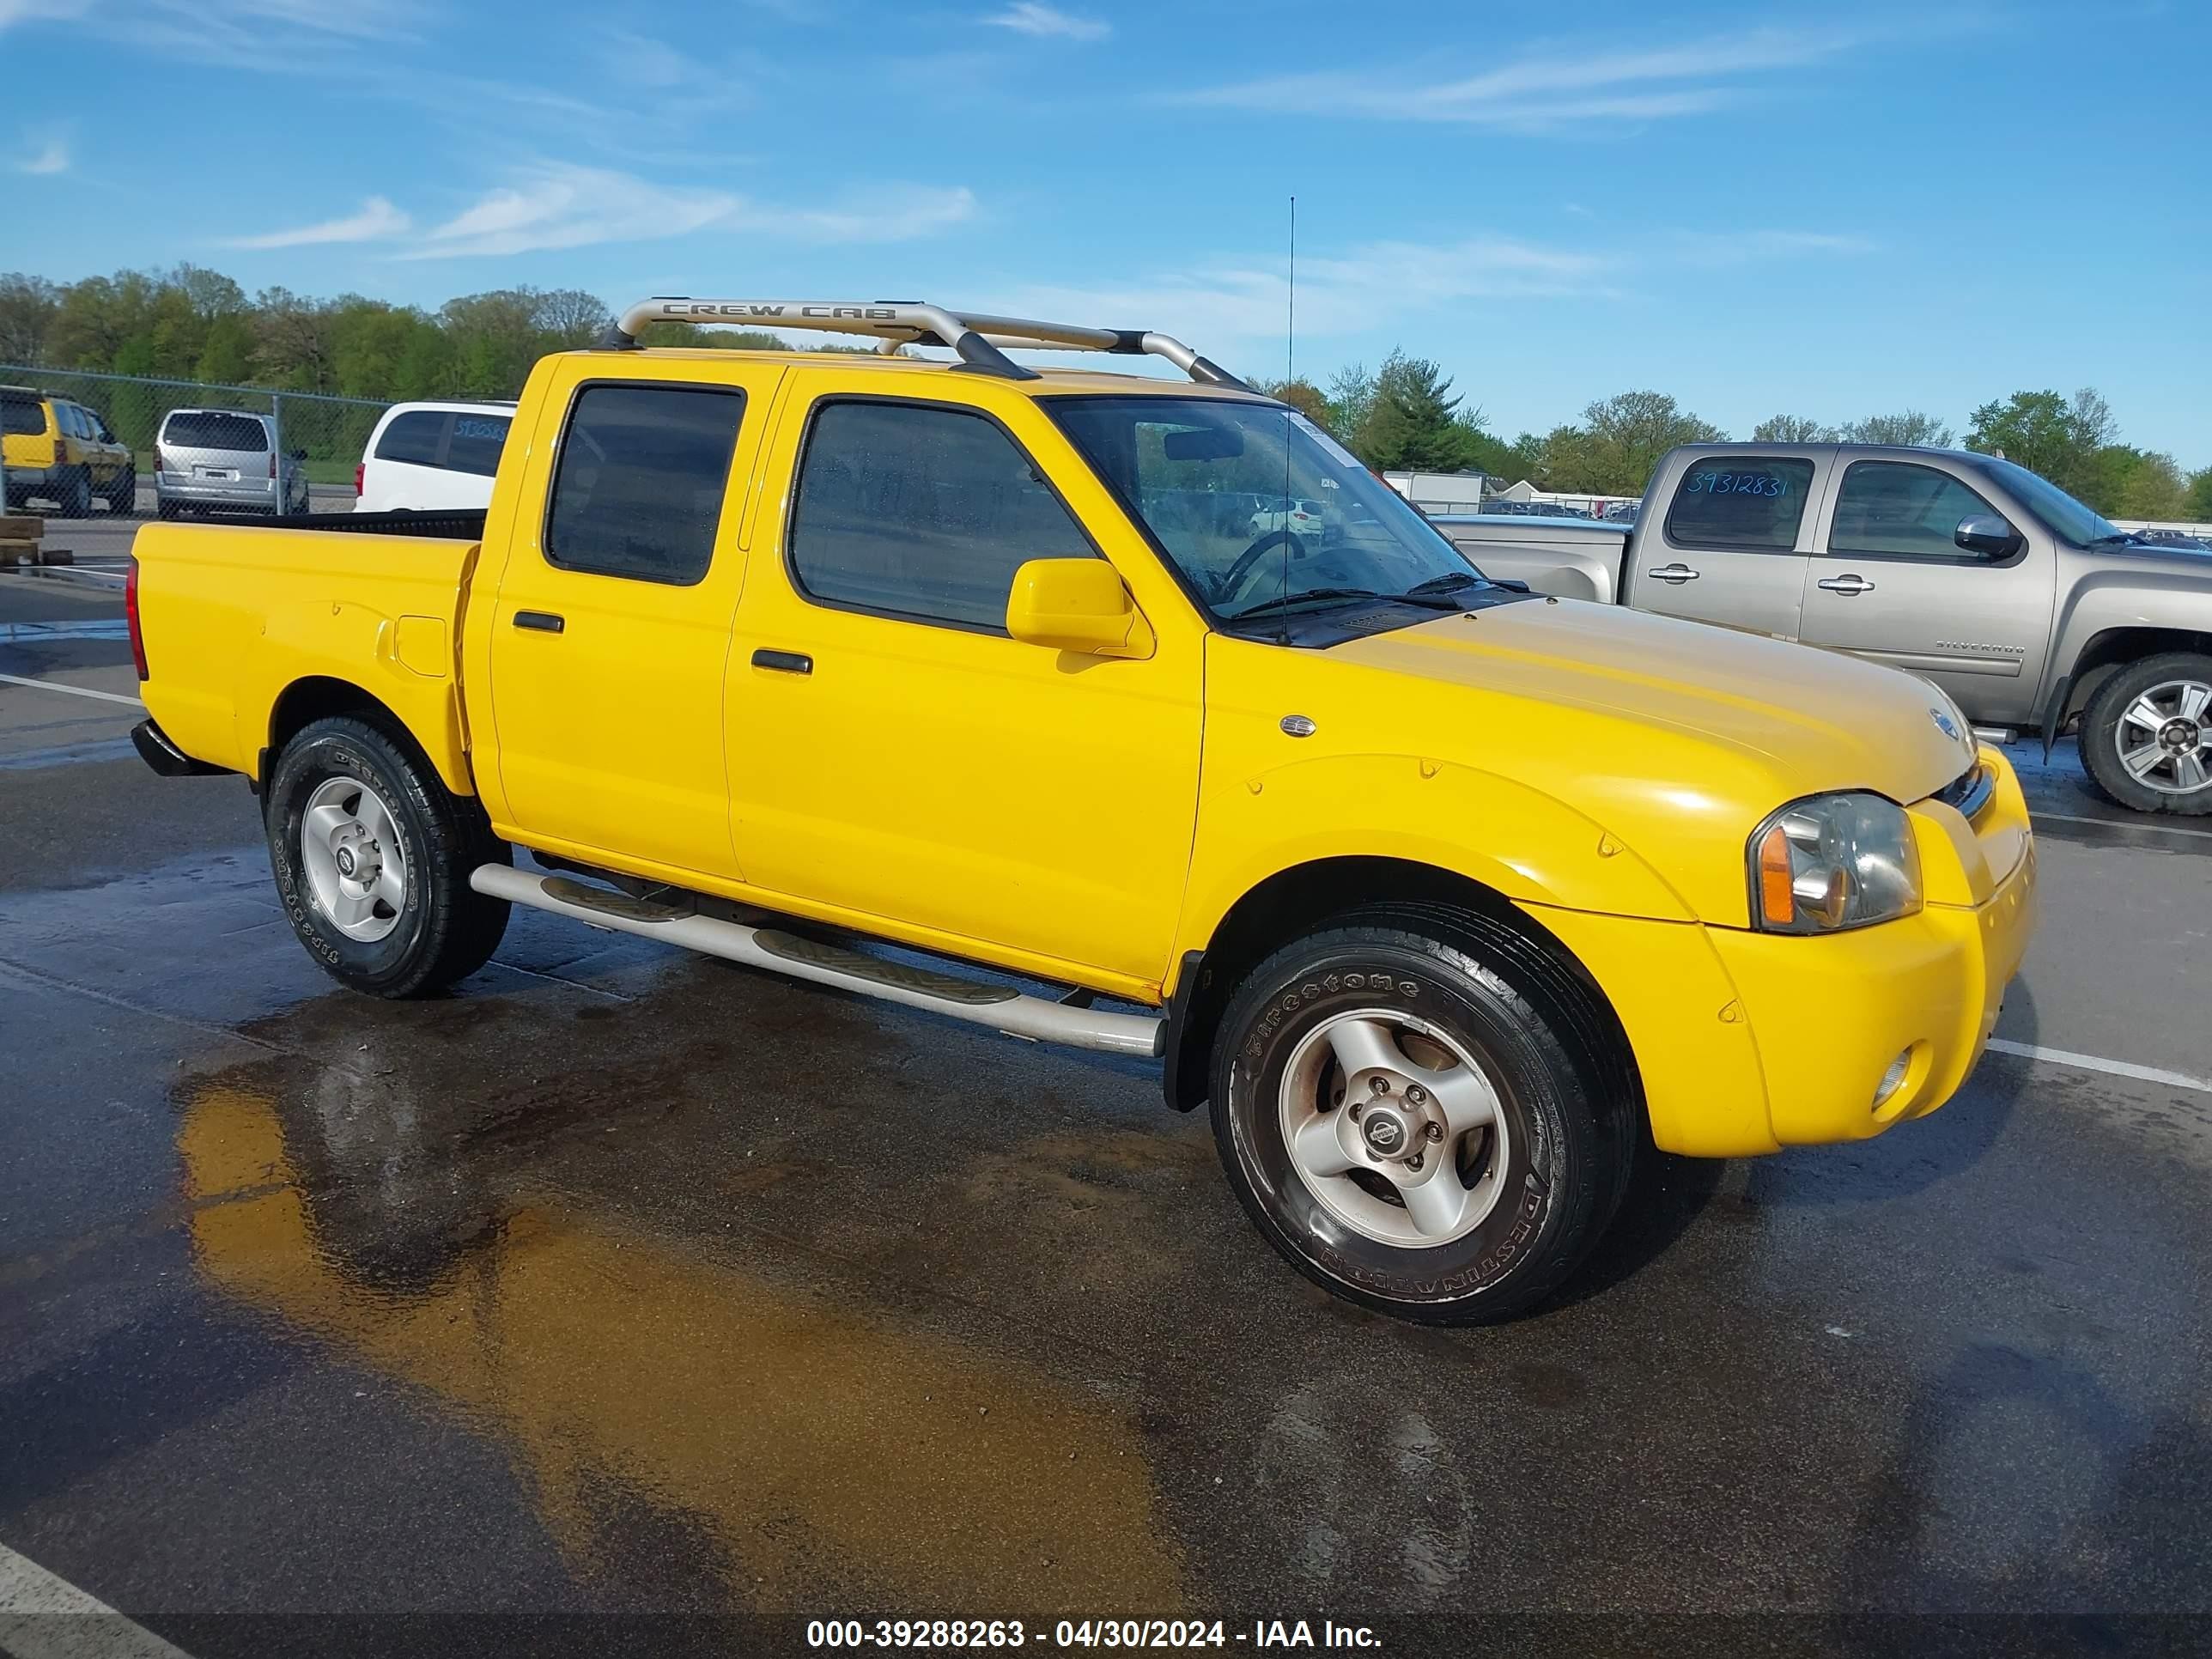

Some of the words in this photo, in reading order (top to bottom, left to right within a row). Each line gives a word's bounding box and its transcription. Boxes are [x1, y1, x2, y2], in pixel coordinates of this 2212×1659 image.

[663, 304, 785, 316] CREW
[801, 307, 896, 319] CAB
[1687, 472, 1788, 496] 39312831
[1936, 641, 2026, 653] SILVERADO
[1245, 973, 1420, 1057] Firestone
[1372, 1127, 1396, 1139] NISSAN
[1317, 1194, 1542, 1294] DESTINATION
